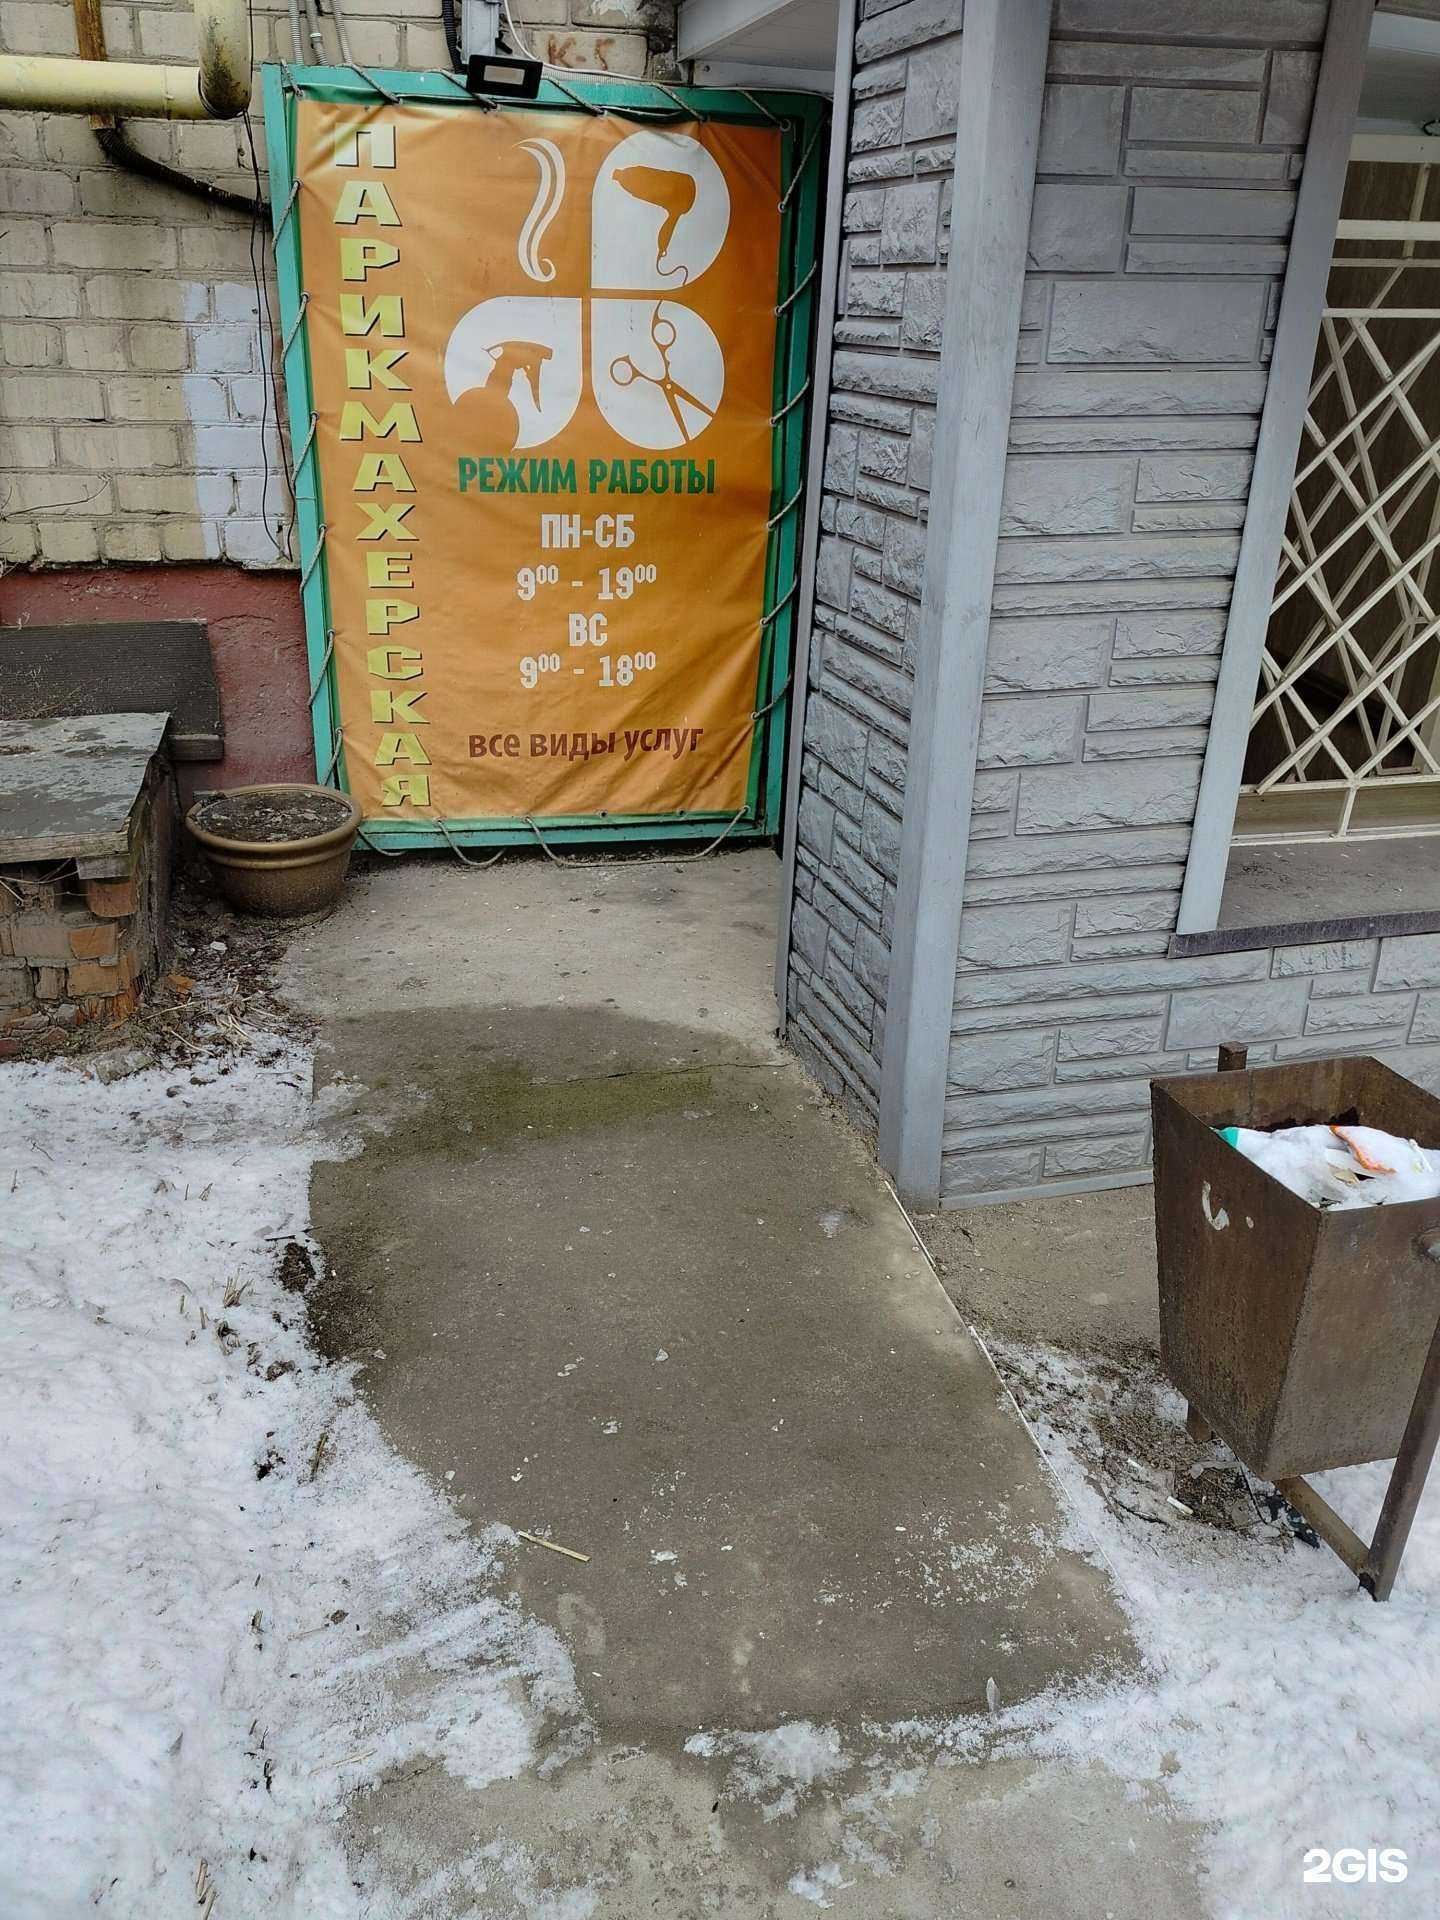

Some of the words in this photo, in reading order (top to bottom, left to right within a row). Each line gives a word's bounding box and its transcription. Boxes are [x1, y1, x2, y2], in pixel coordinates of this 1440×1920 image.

[333, 122, 432, 807] ПАРИКМАХЕРСКАЯ
[457, 456, 577, 494] РЕЖИМ
[588, 458, 715, 495] РАБОТЫ
[541, 513, 635, 549] ПН-СБ
[568, 612, 608, 647] ВС
[529, 732, 616, 761] виды
[623, 727, 704, 761] услуг
